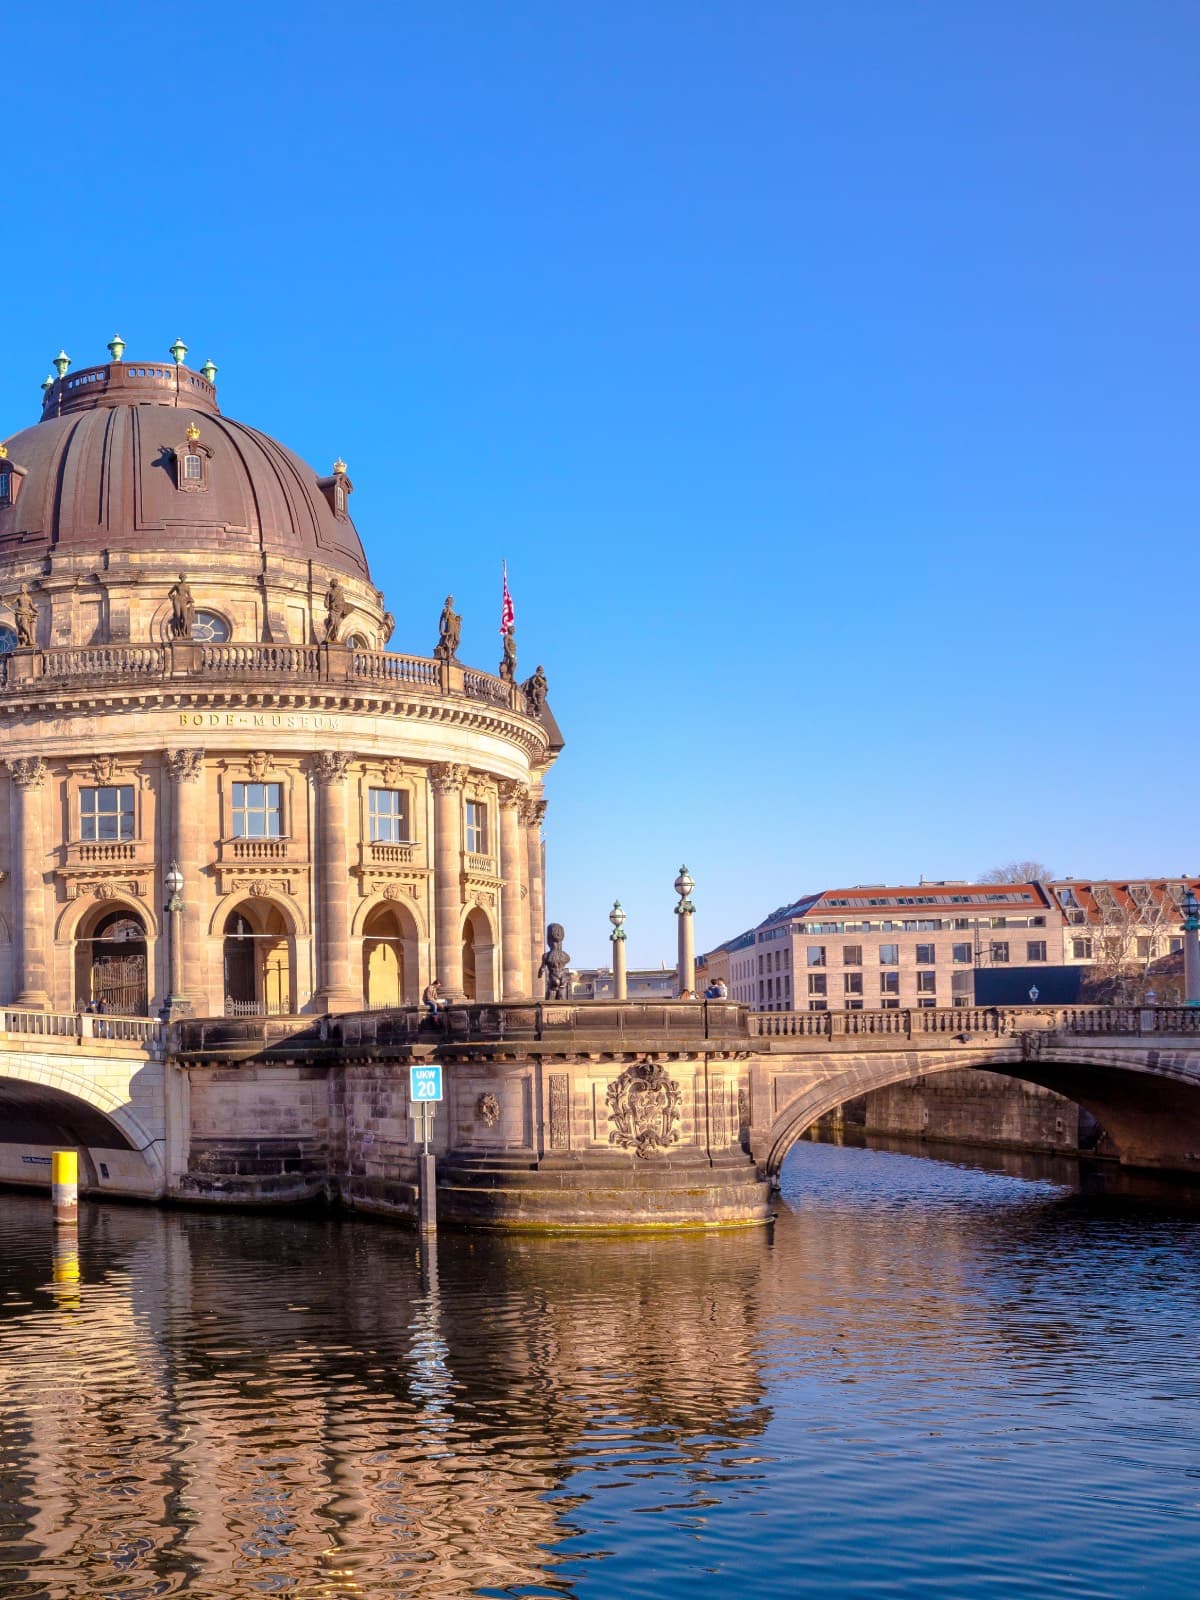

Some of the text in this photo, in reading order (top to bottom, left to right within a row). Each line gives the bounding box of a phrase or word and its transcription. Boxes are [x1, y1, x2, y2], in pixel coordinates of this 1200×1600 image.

[179, 714, 339, 729] BODE-MUSEUM
[416, 1070, 435, 1079] UKW
[417, 1081, 435, 1097] 20
